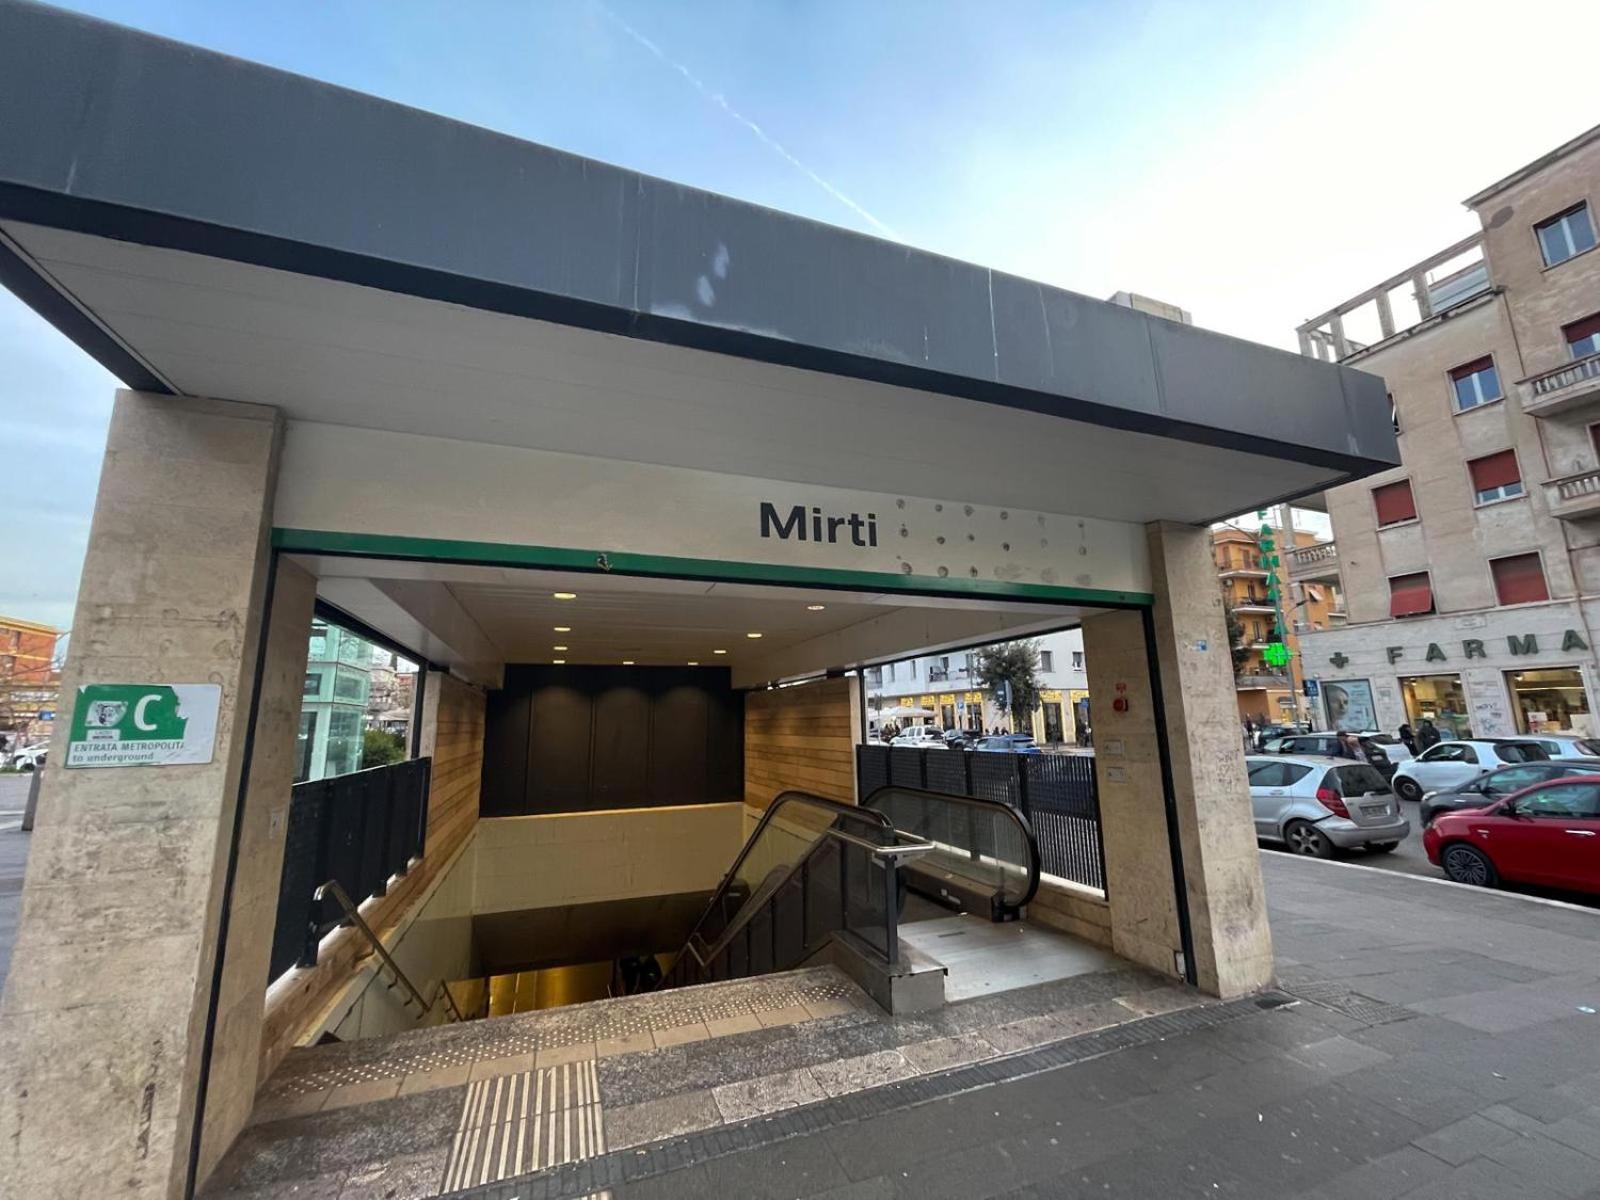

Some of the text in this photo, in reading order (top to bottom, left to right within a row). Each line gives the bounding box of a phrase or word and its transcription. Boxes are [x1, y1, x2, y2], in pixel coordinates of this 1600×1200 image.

[760, 502, 877, 547] Mirti
[1386, 629, 1589, 665] FARMA
[134, 694, 162, 731] C
[73, 753, 154, 764] to underground
[74, 743, 117, 752] ENTRATA
